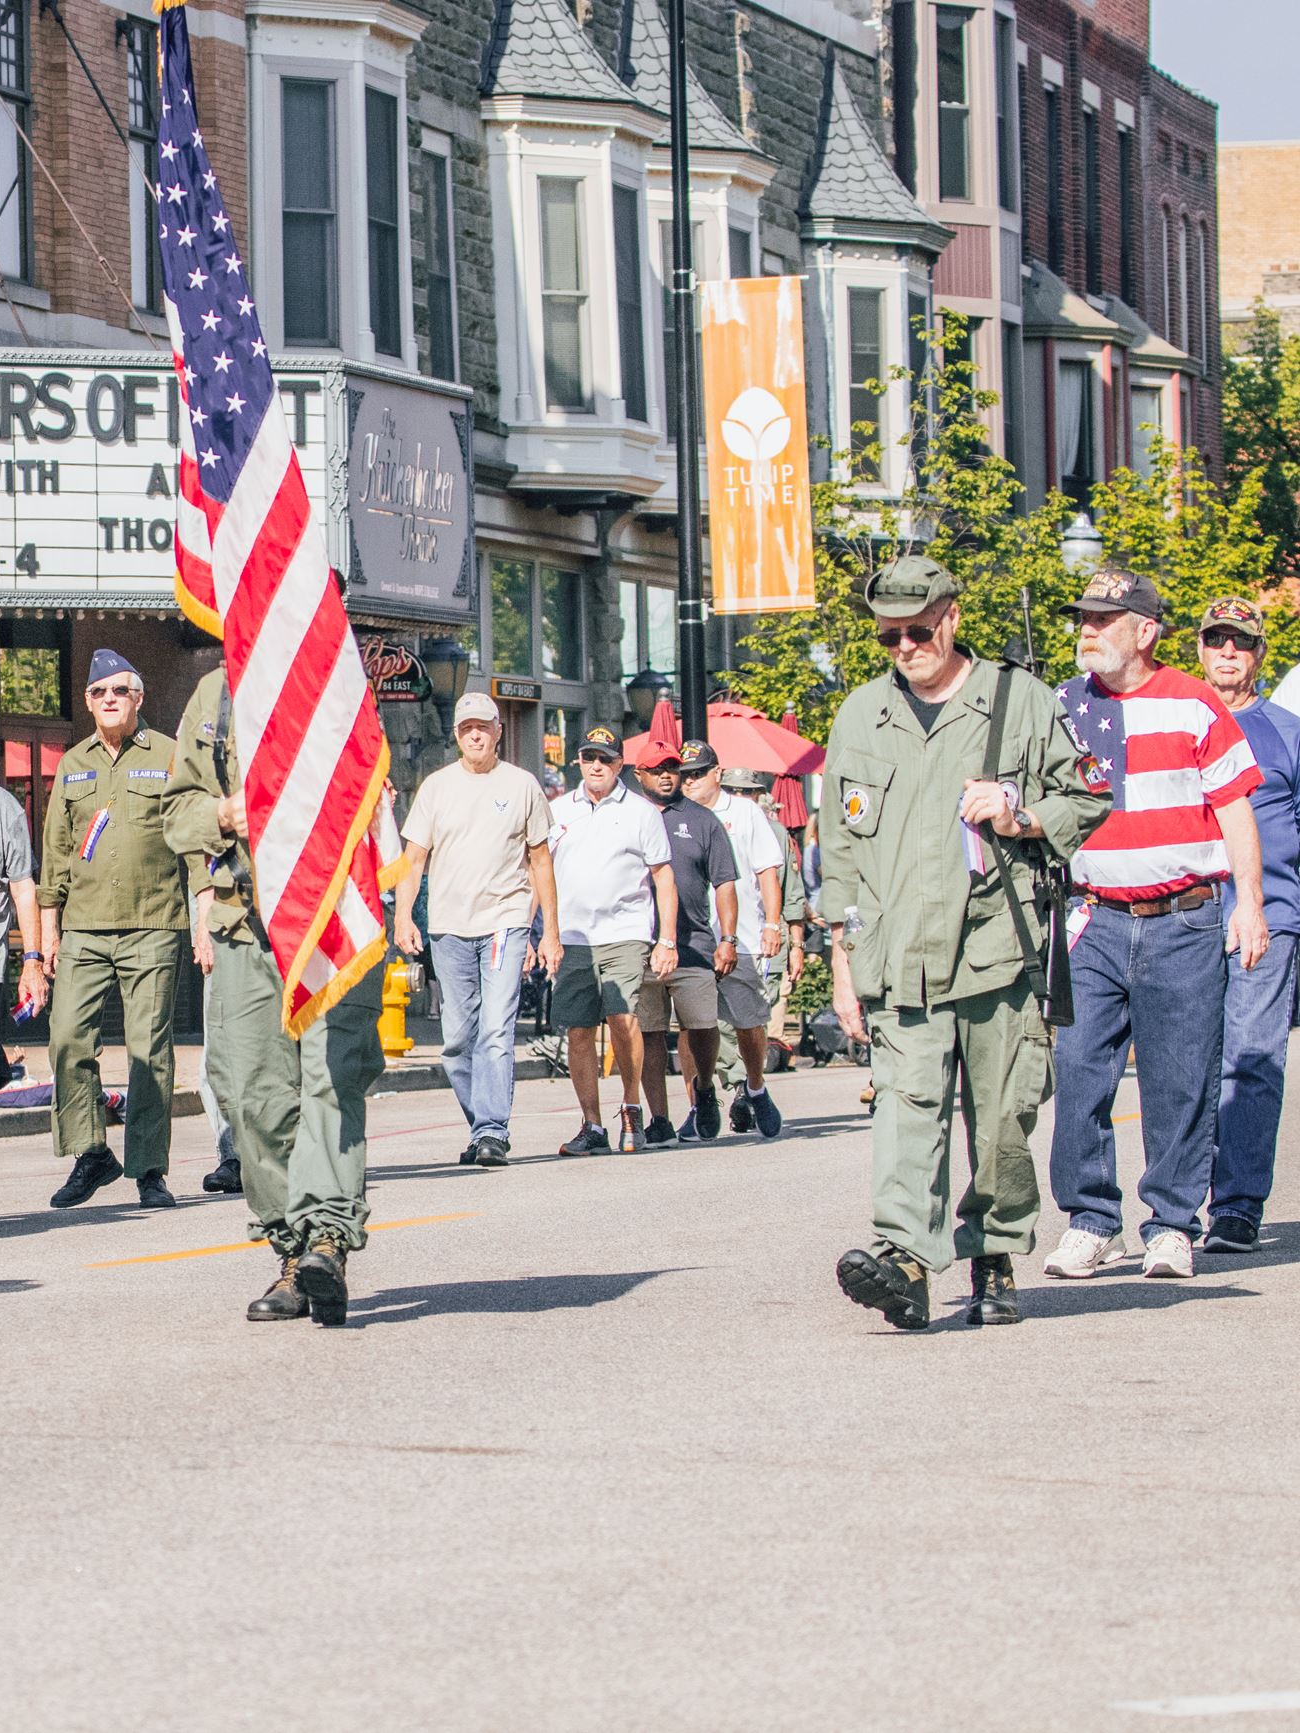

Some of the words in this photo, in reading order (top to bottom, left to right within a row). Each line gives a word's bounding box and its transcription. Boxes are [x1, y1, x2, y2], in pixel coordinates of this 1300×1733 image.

[87, 373, 158, 442] OF
[723, 464, 794, 485] TULIP
[725, 485, 795, 507] TIME
[393, 681, 411, 690] EAST
[67, 772, 88, 782] GEORGE
[139, 770, 150, 778] AIR
[150, 770, 167, 779] FORC
